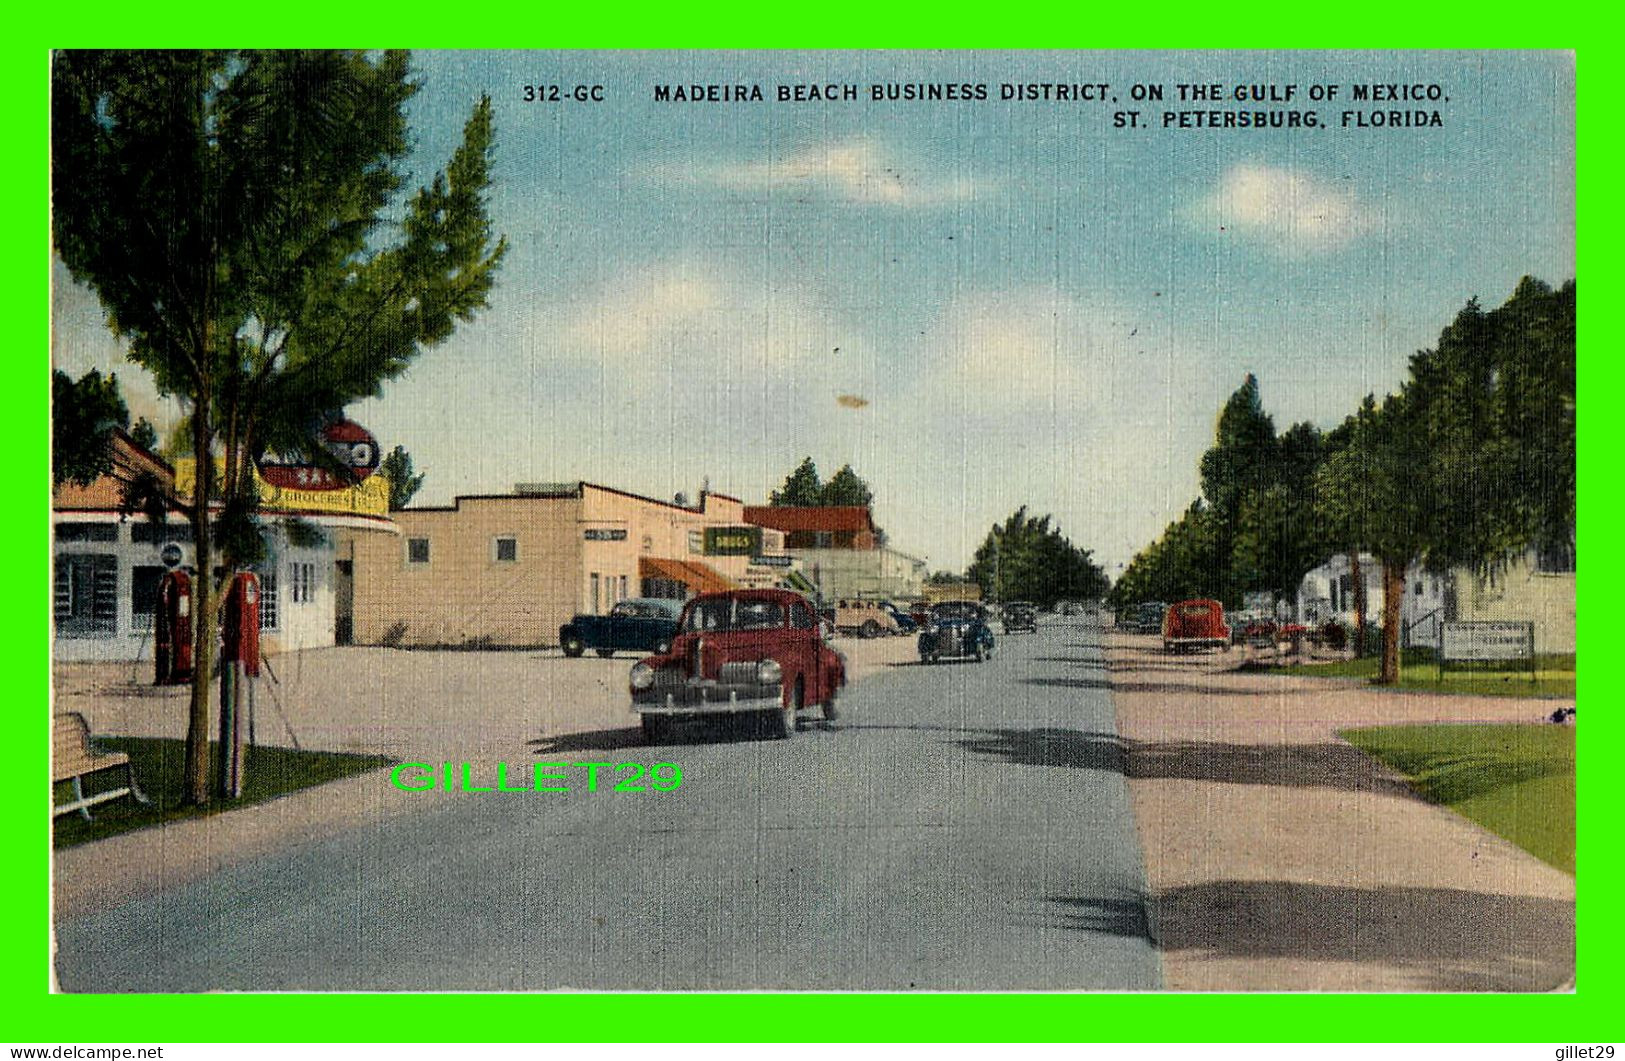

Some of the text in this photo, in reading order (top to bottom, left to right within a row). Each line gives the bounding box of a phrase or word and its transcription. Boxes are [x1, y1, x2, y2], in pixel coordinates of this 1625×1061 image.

[523, 83, 1449, 104] 312-GC MADEIRA BEACH BUSINESS DISTRICT, ON THE GULF OF MEXICO,
[1113, 110, 1443, 130] ST. PETERSBURG, FLORIDA
